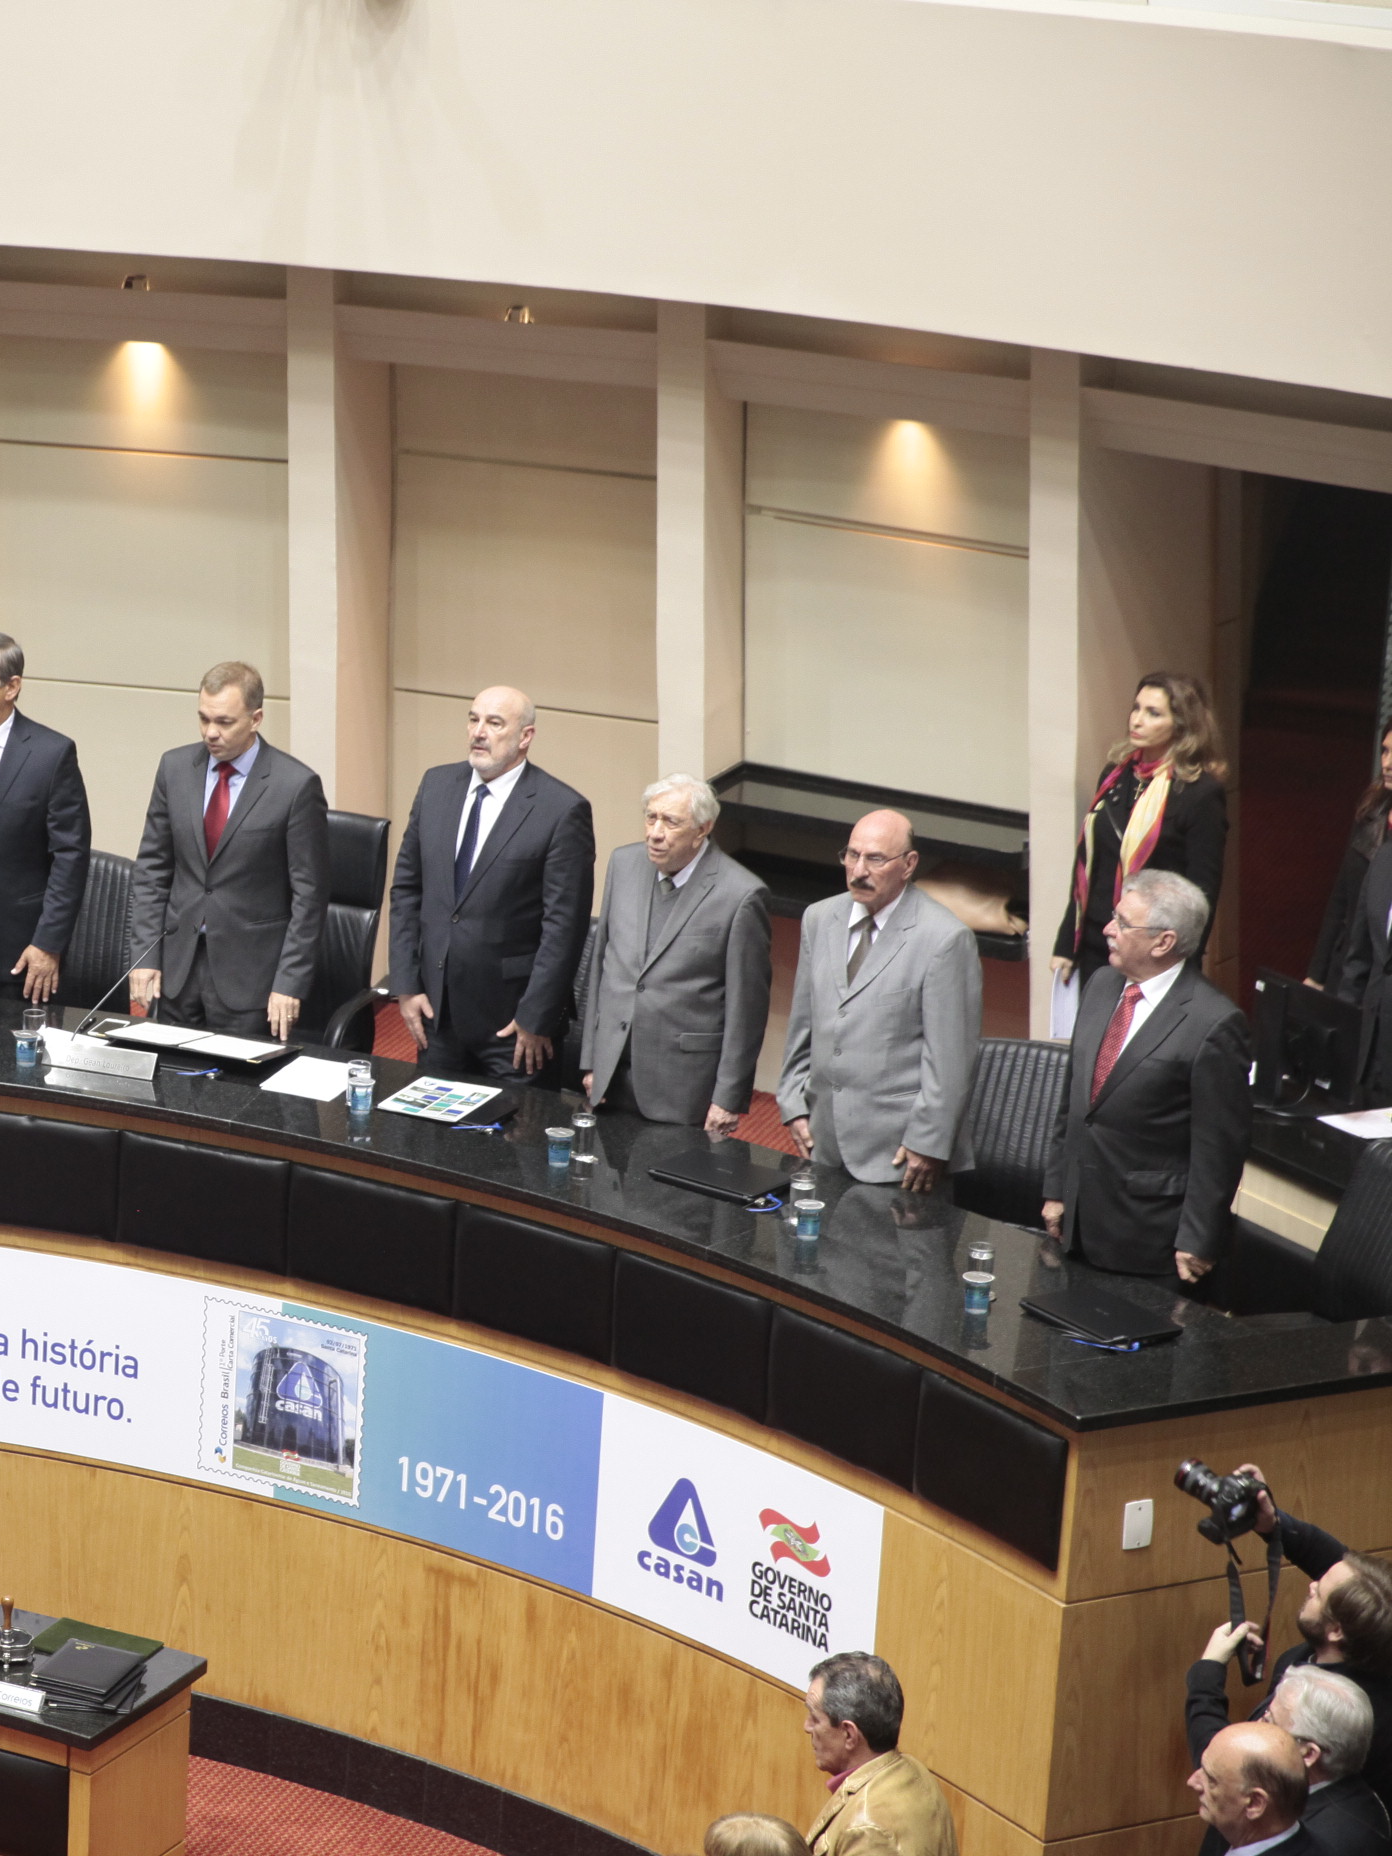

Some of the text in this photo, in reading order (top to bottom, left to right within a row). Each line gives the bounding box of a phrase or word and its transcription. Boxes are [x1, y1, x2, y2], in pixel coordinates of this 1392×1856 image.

[21, 1328, 139, 1380] história
[30, 1375, 133, 1424] futuro.
[219, 1371, 230, 1446] Correios Brasil
[397, 1456, 565, 1541] 1971-2016
[637, 1549, 724, 1602] casan
[751, 1561, 832, 1612] GOVERNO
[748, 1599, 829, 1653] CATARINA
[750, 1579, 829, 1633] DE SANTA
